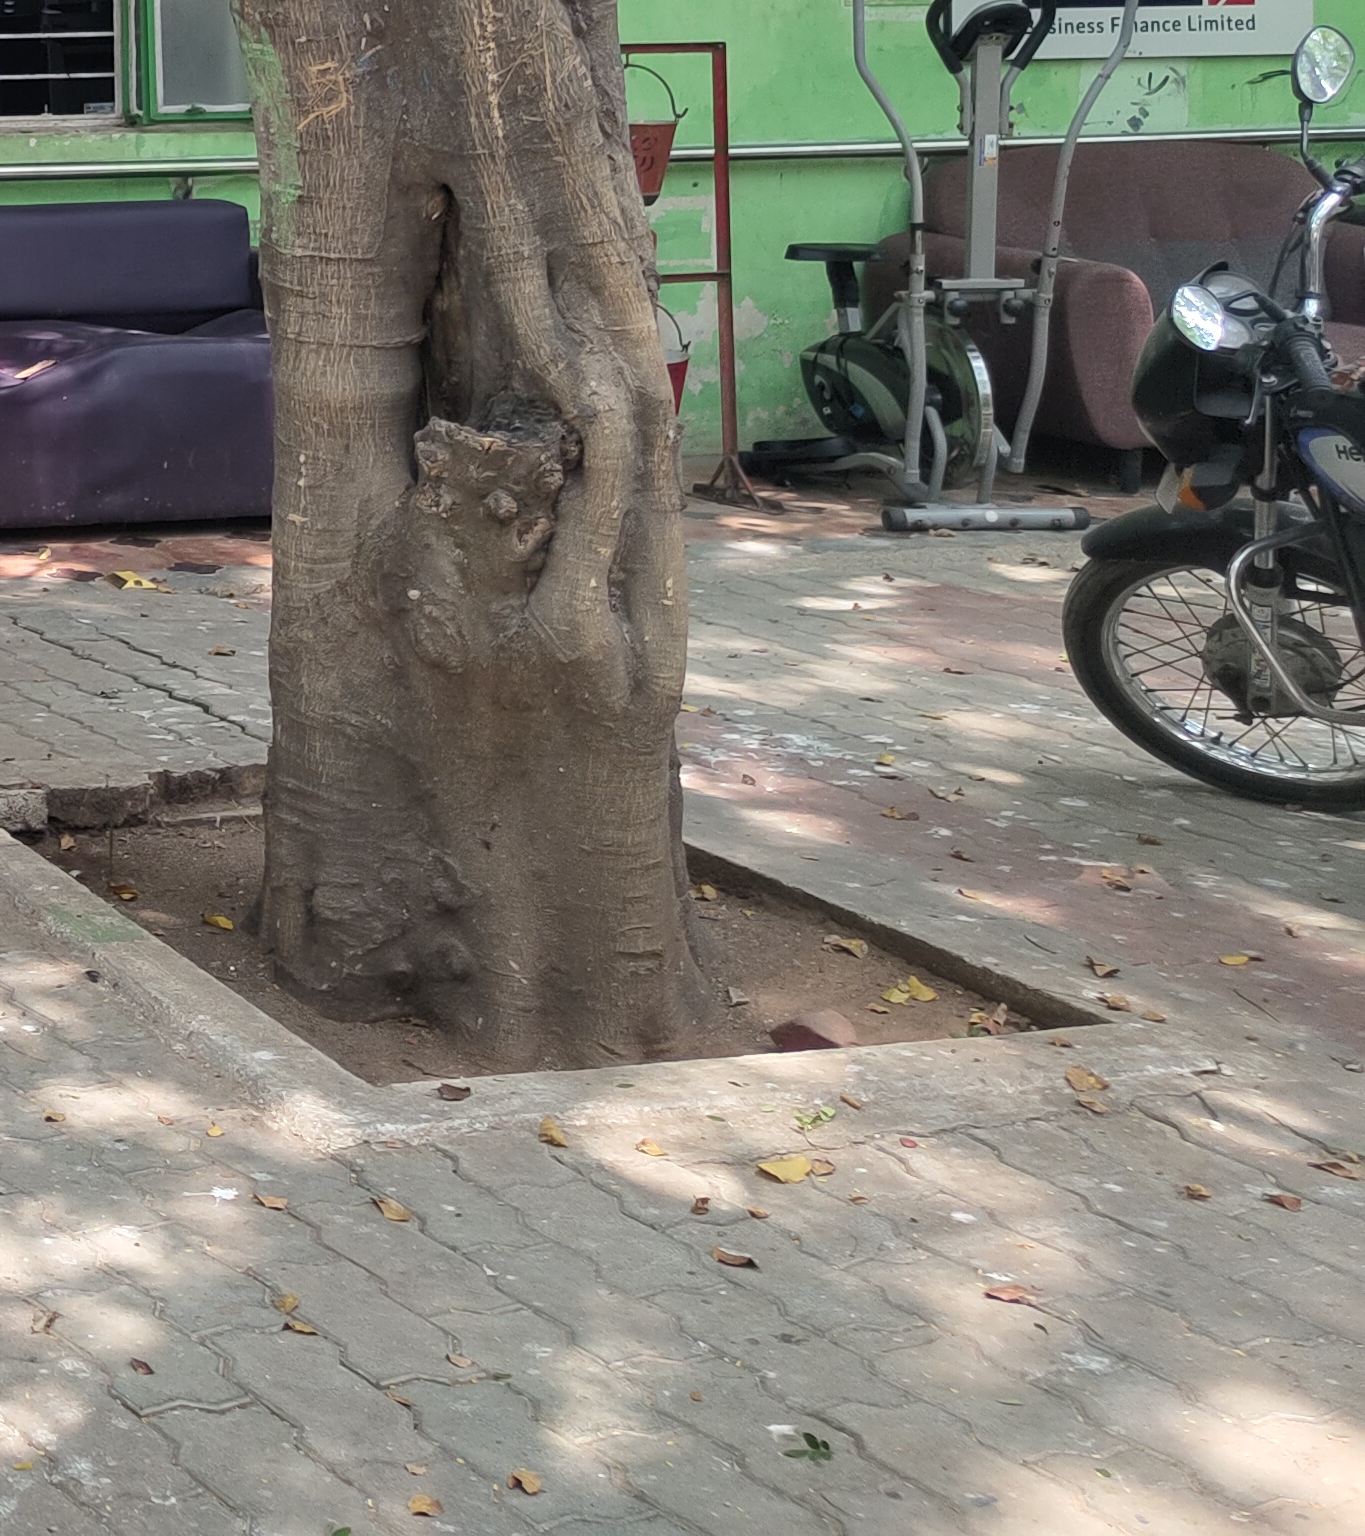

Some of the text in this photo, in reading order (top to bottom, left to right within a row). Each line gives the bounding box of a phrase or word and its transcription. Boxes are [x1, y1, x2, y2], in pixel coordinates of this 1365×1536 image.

[1110, 16, 1182, 34] Fance
[1187, 13, 1256, 32] Limited
[1335, 444, 1365, 463] He
